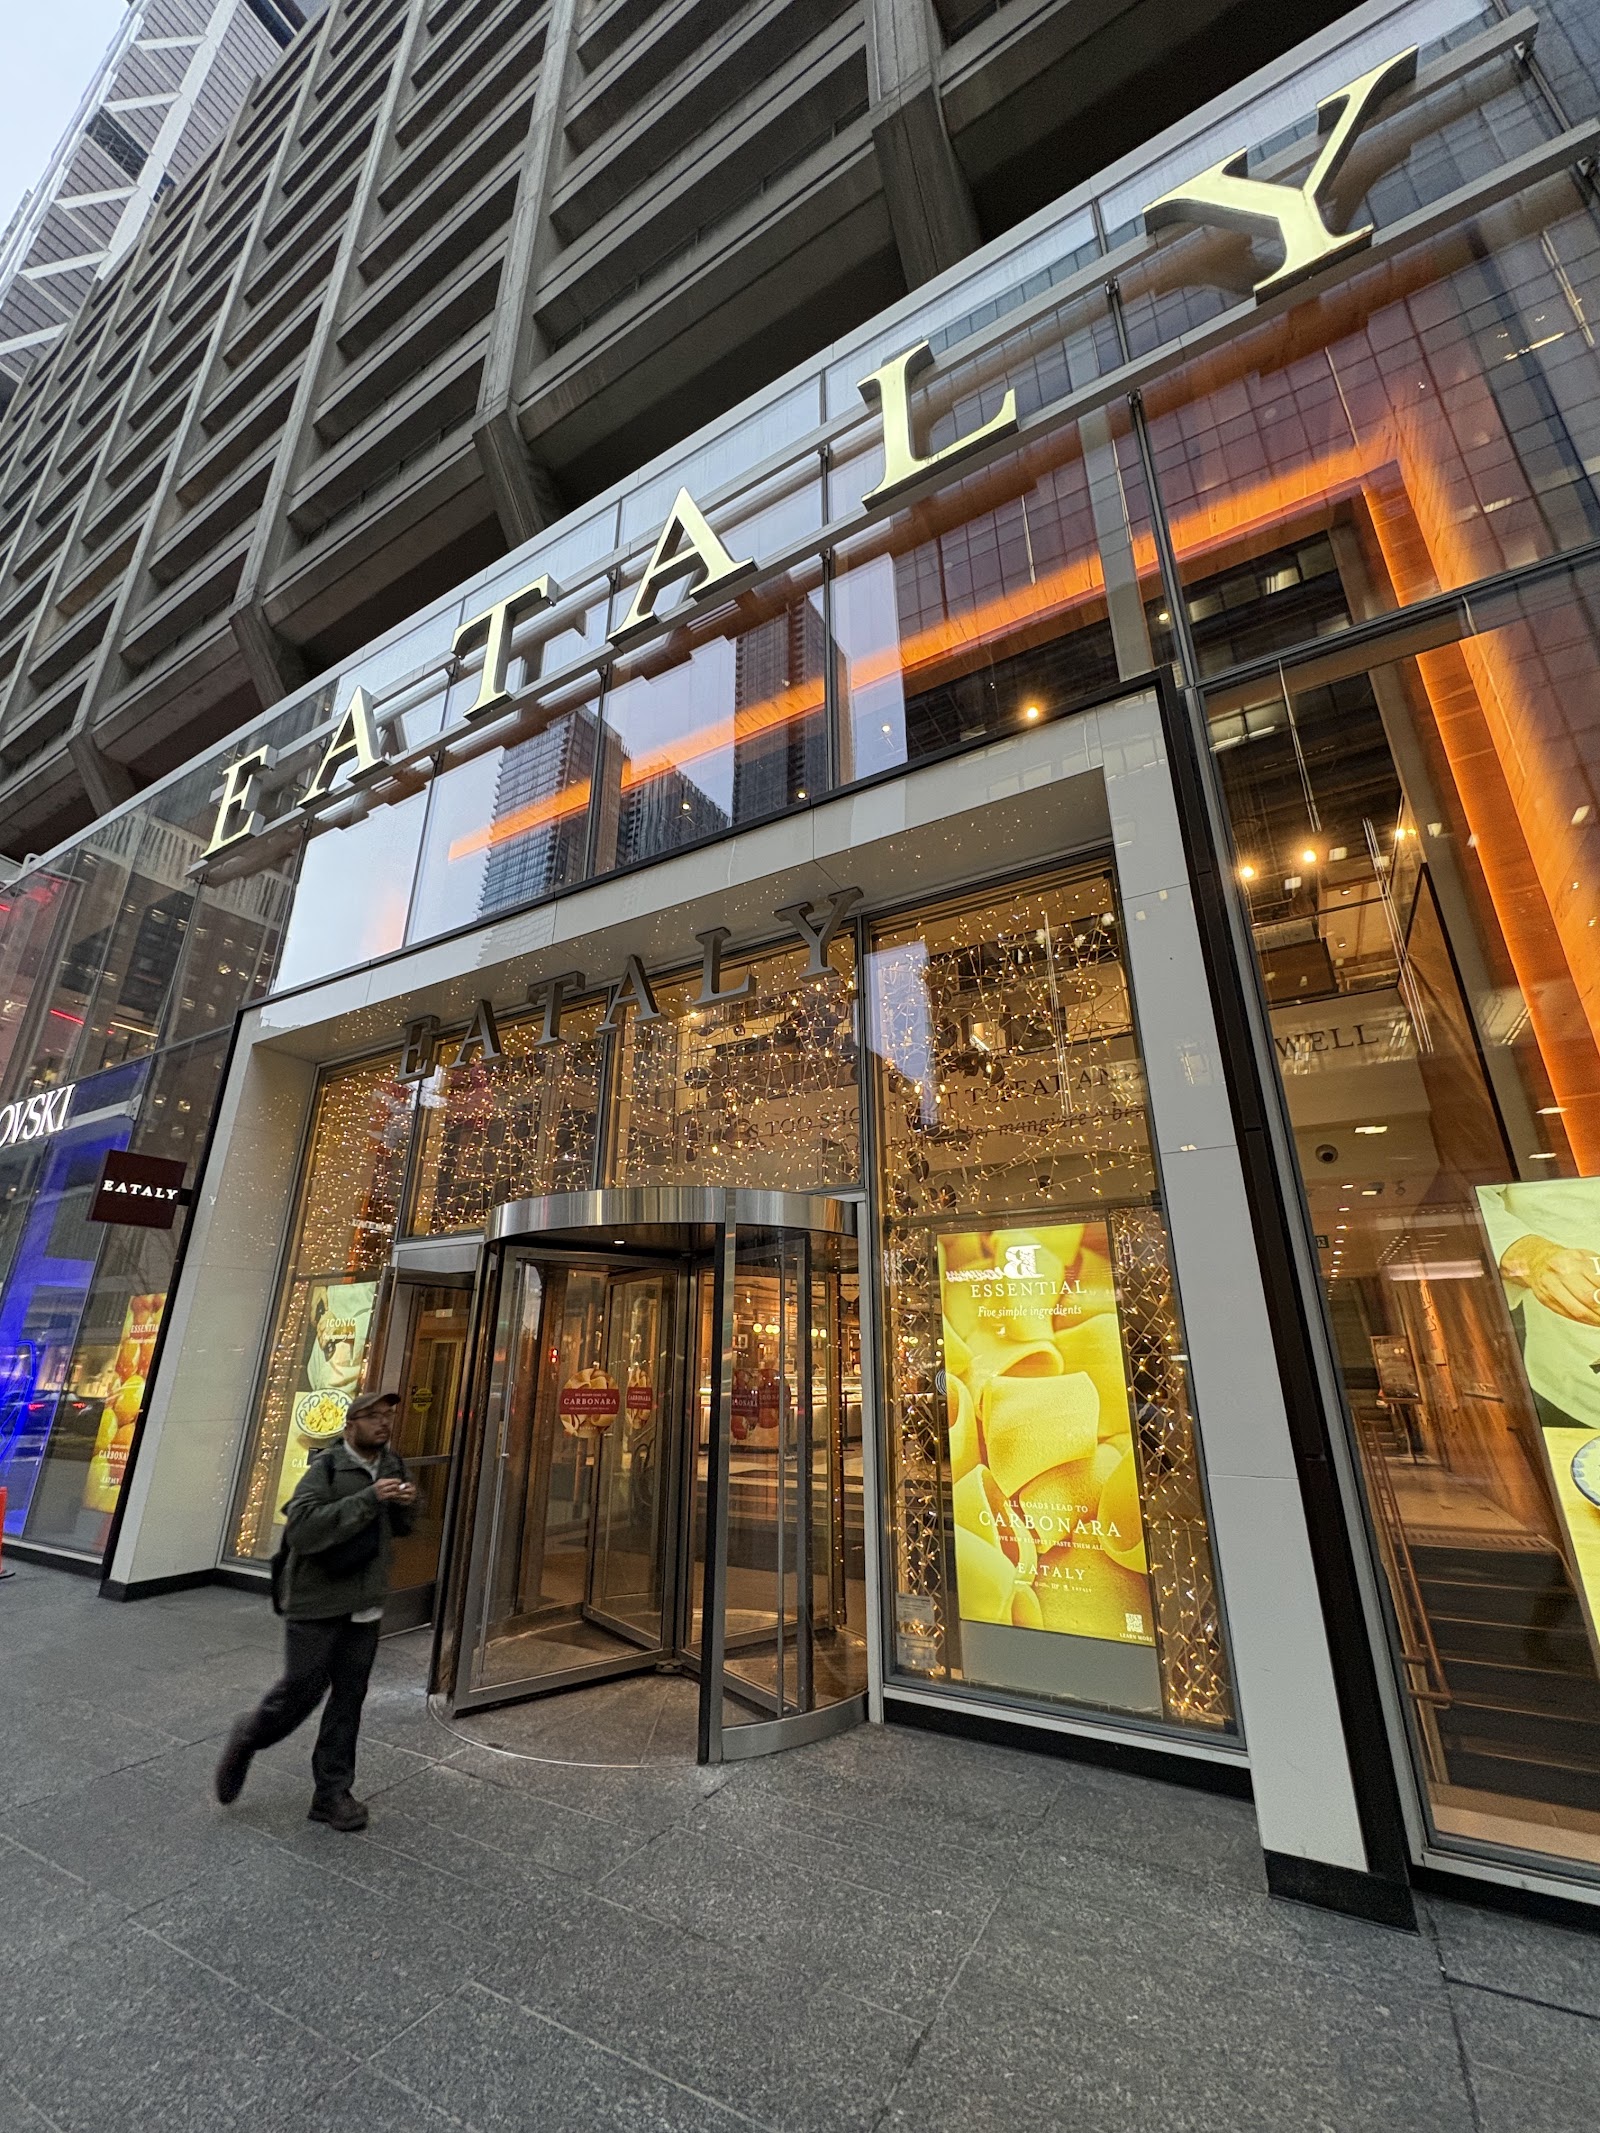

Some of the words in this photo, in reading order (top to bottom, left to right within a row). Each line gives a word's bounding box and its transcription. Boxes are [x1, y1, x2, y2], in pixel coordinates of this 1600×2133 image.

[202, 47, 1418, 862] EATALY
[395, 886, 865, 1084] EATALY
[1274, 1024, 1379, 1058] WELL
[0, 1083, 76, 1147] OVSKI
[102, 1180, 179, 1200] EATALY
[970, 1279, 1088, 1298] ESSENTIAL
[977, 1305, 998, 1318] Five
[998, 1303, 1028, 1320] simple
[1030, 1303, 1083, 1320] ingredients
[326, 1317, 356, 1328] ICONIC
[1003, 1499, 1019, 1508] ALL
[1021, 1501, 1049, 1510] ROADS
[1051, 1503, 1073, 1512] LEAD
[1075, 1504, 1089, 1513] TO
[979, 1510, 1122, 1538] CARBONARA
[1053, 1540, 1071, 1548] TASTE
[1072, 1541, 1091, 1550] THEM
[1091, 1543, 1104, 1551] ALL
[1017, 1562, 1086, 1581] EATALY
